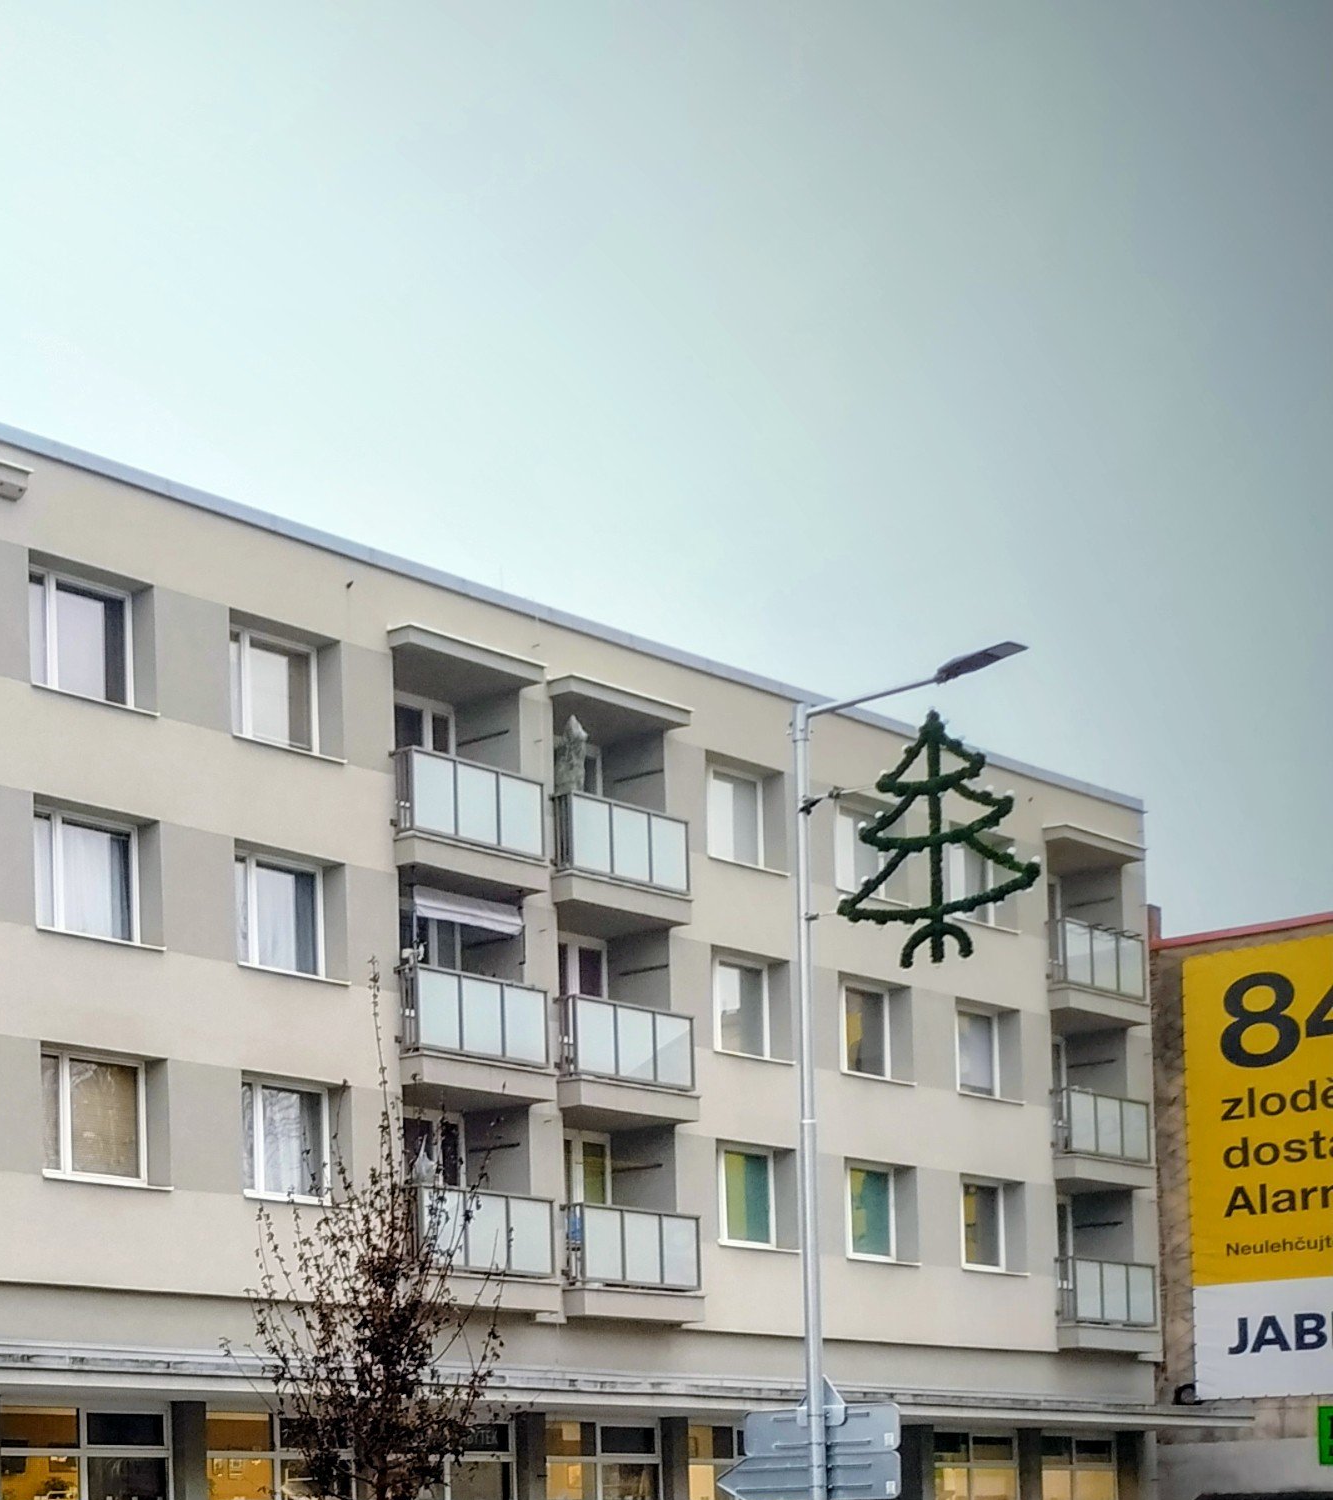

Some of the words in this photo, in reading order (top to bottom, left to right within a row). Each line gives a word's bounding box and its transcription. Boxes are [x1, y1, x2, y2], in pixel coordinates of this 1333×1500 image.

[1223, 1130, 1333, 1169] dost
[1226, 1234, 1333, 1257] Neulehčujt
[1228, 1311, 1333, 1355] JAB
